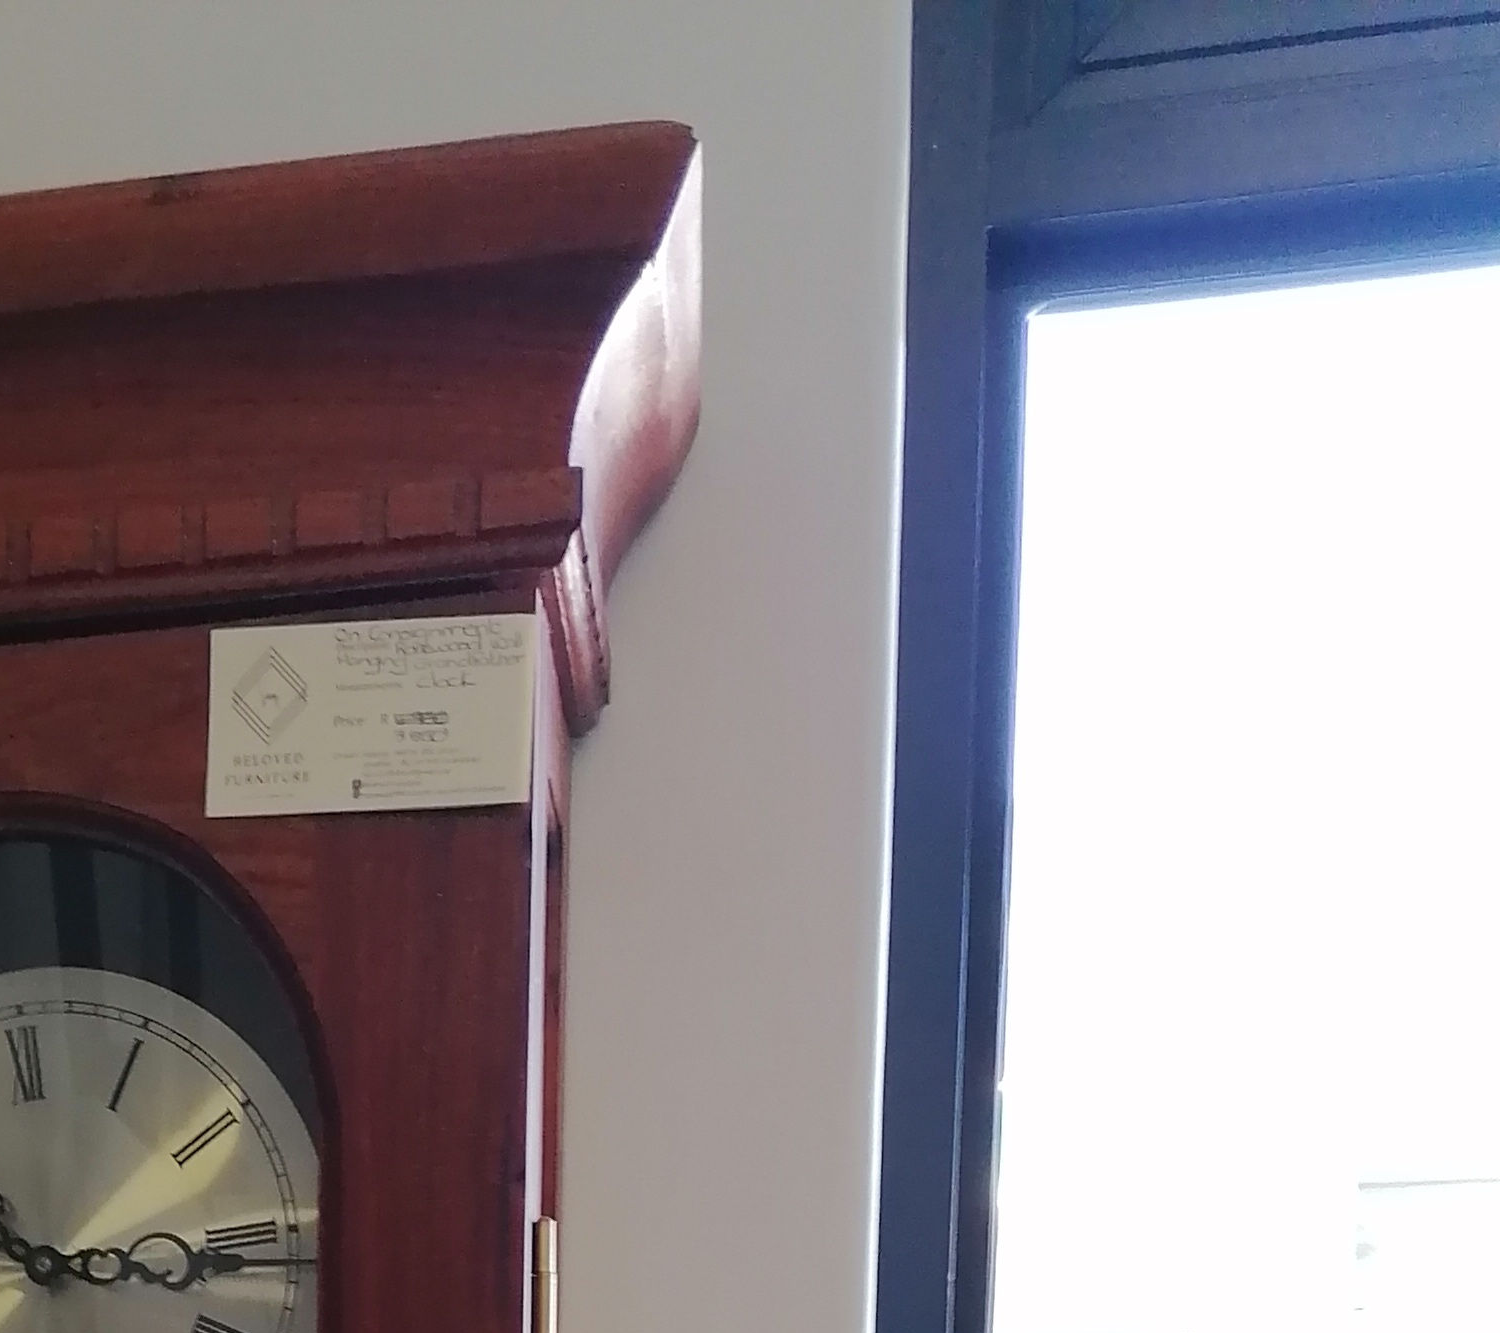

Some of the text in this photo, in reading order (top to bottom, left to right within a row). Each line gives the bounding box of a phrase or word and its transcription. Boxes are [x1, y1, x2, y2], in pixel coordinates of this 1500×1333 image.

[4, 1025, 46, 1105] XII
[171, 1107, 240, 1168] II
[205, 1217, 278, 1249] III
